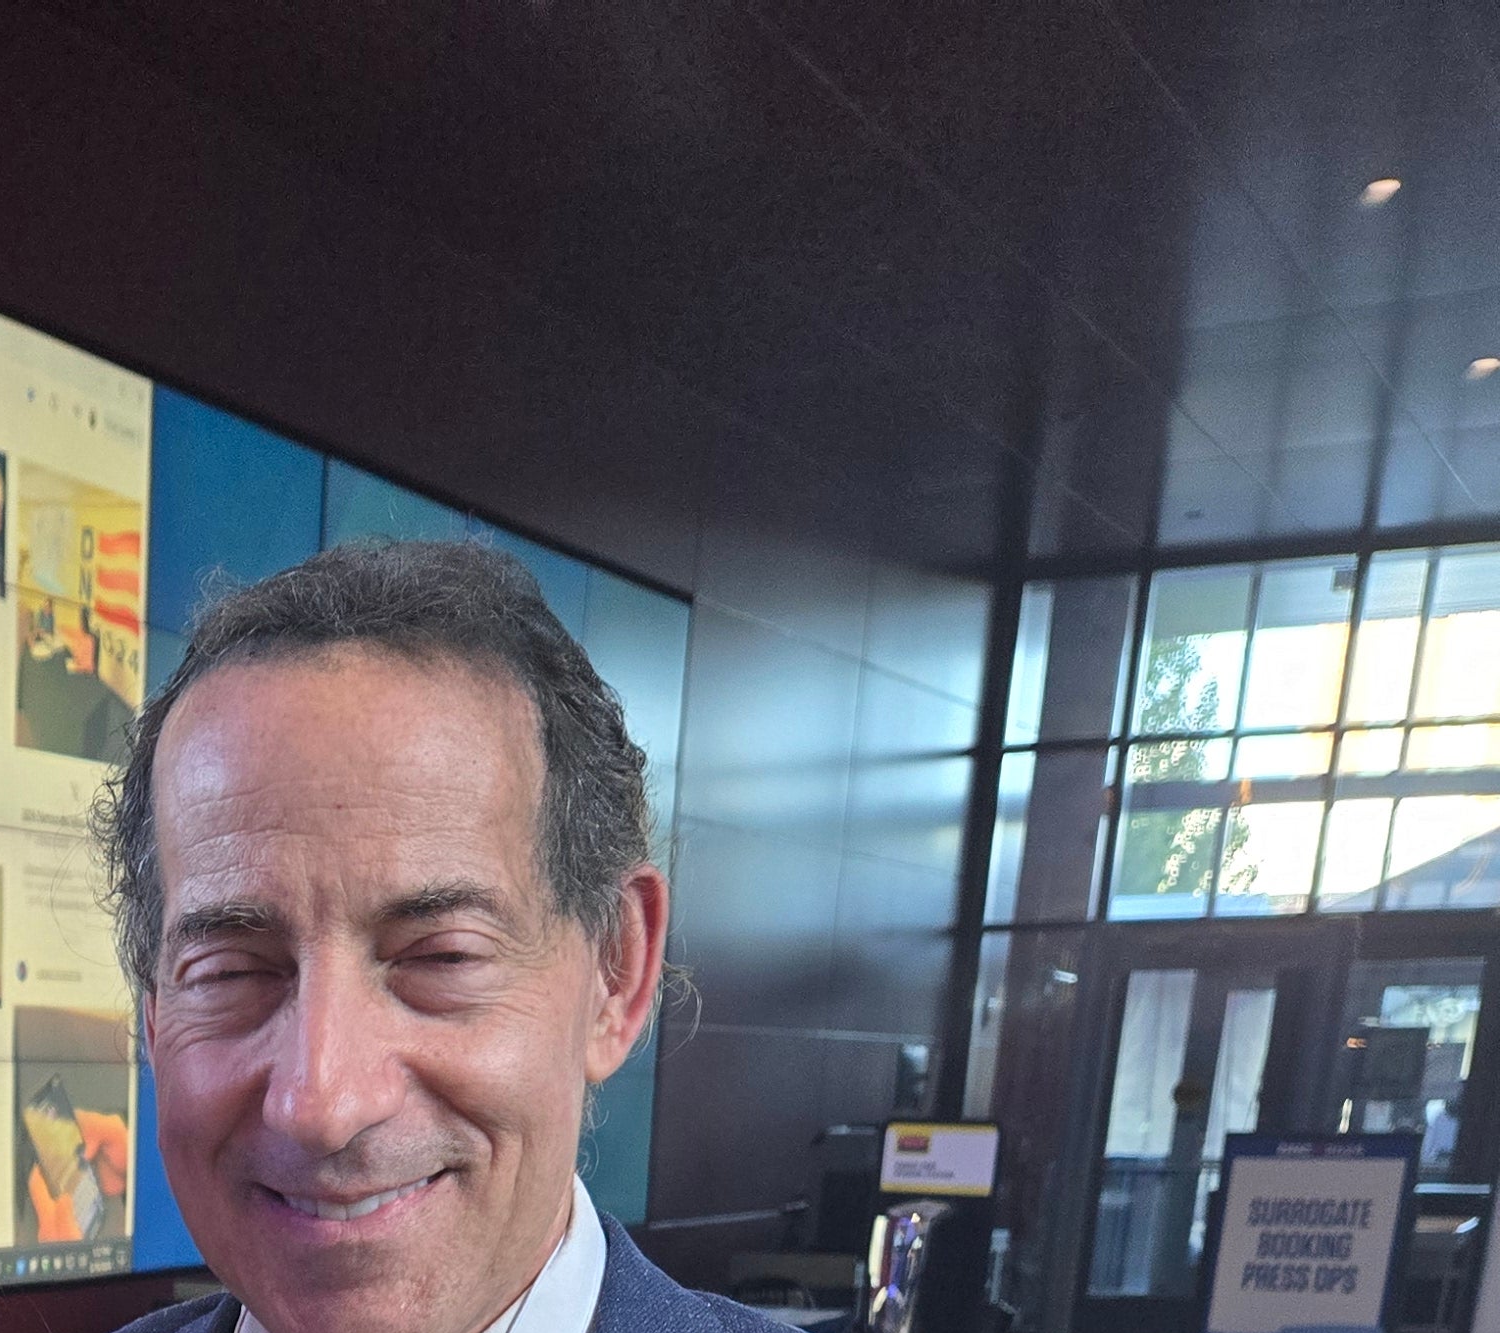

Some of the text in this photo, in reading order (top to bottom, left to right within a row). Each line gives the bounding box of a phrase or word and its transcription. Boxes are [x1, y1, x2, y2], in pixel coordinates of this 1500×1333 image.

[1246, 1199, 1373, 1229] SURROGATE
[1256, 1232, 1353, 1259] BOOKING
[1241, 1263, 1358, 1294] PRESS OPS
